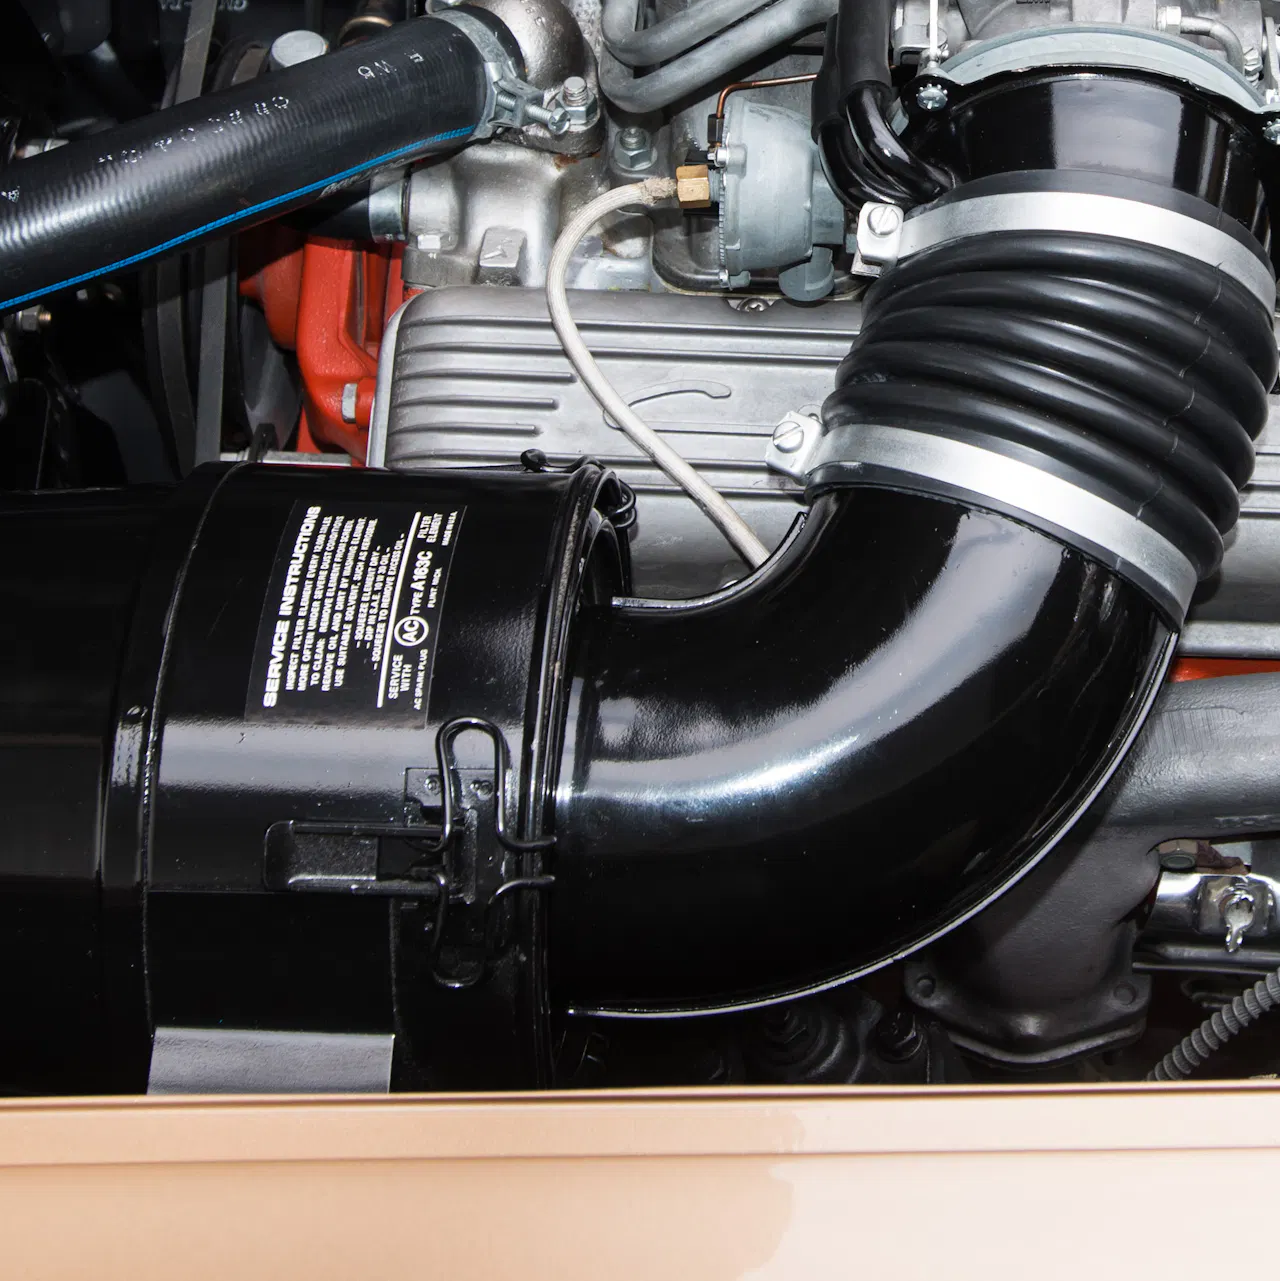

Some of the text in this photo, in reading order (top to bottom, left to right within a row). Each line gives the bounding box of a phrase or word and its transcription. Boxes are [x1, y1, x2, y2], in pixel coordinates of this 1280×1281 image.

[418, 516, 432, 538] FILTER
[427, 513, 443, 543] ELEMENT
[335, 543, 347, 562] FROM
[359, 551, 368, 560] AS
[395, 539, 404, 550] OIL
[321, 552, 333, 569] DUST
[343, 546, 358, 576] WASHING
[354, 562, 365, 580] SUCH
[381, 553, 390, 565] OIL
[388, 551, 401, 575] EXCESS
[314, 570, 328, 599] SEVERE
[327, 563, 341, 596] ELEMENT
[340, 578, 349, 588] BY
[381, 576, 395, 608] REMOVE
[263, 506, 321, 707] SERVICE INSTRUCTIONS
[336, 590, 346, 610] DIRT
[355, 602, 369, 640] SQUEEZE
[362, 567, 376, 601] ELEMENT
[370, 551, 380, 566] DRY
[402, 550, 433, 642] AC TYPE A163C
[286, 652, 298, 690] INSPECT
[292, 618, 305, 650] FILTER
[299, 580, 313, 616] ELEMENT
[307, 554, 320, 578] EVERY
[308, 600, 321, 630] UNDER
[319, 598, 333, 633] REMOVE
[332, 612, 342, 631] AND
[367, 615, 376, 624] IN
[379, 609, 388, 621] TO
[302, 632, 315, 661] OFTEN
[328, 634, 338, 650] OIL
[338, 624, 352, 666] SUITABLE
[365, 626, 374, 640] DIP
[372, 622, 386, 661] SQUEEZE
[313, 638, 326, 670] CLEAN:
[298, 663, 309, 691] MORE
[311, 672, 320, 686] TO
[322, 652, 335, 691] REMOVE
[335, 669, 345, 686] USE
[389, 654, 403, 699] SERVICE
[401, 664, 412, 691] WITH
[414, 648, 428, 710] AC SPARK PLUG
